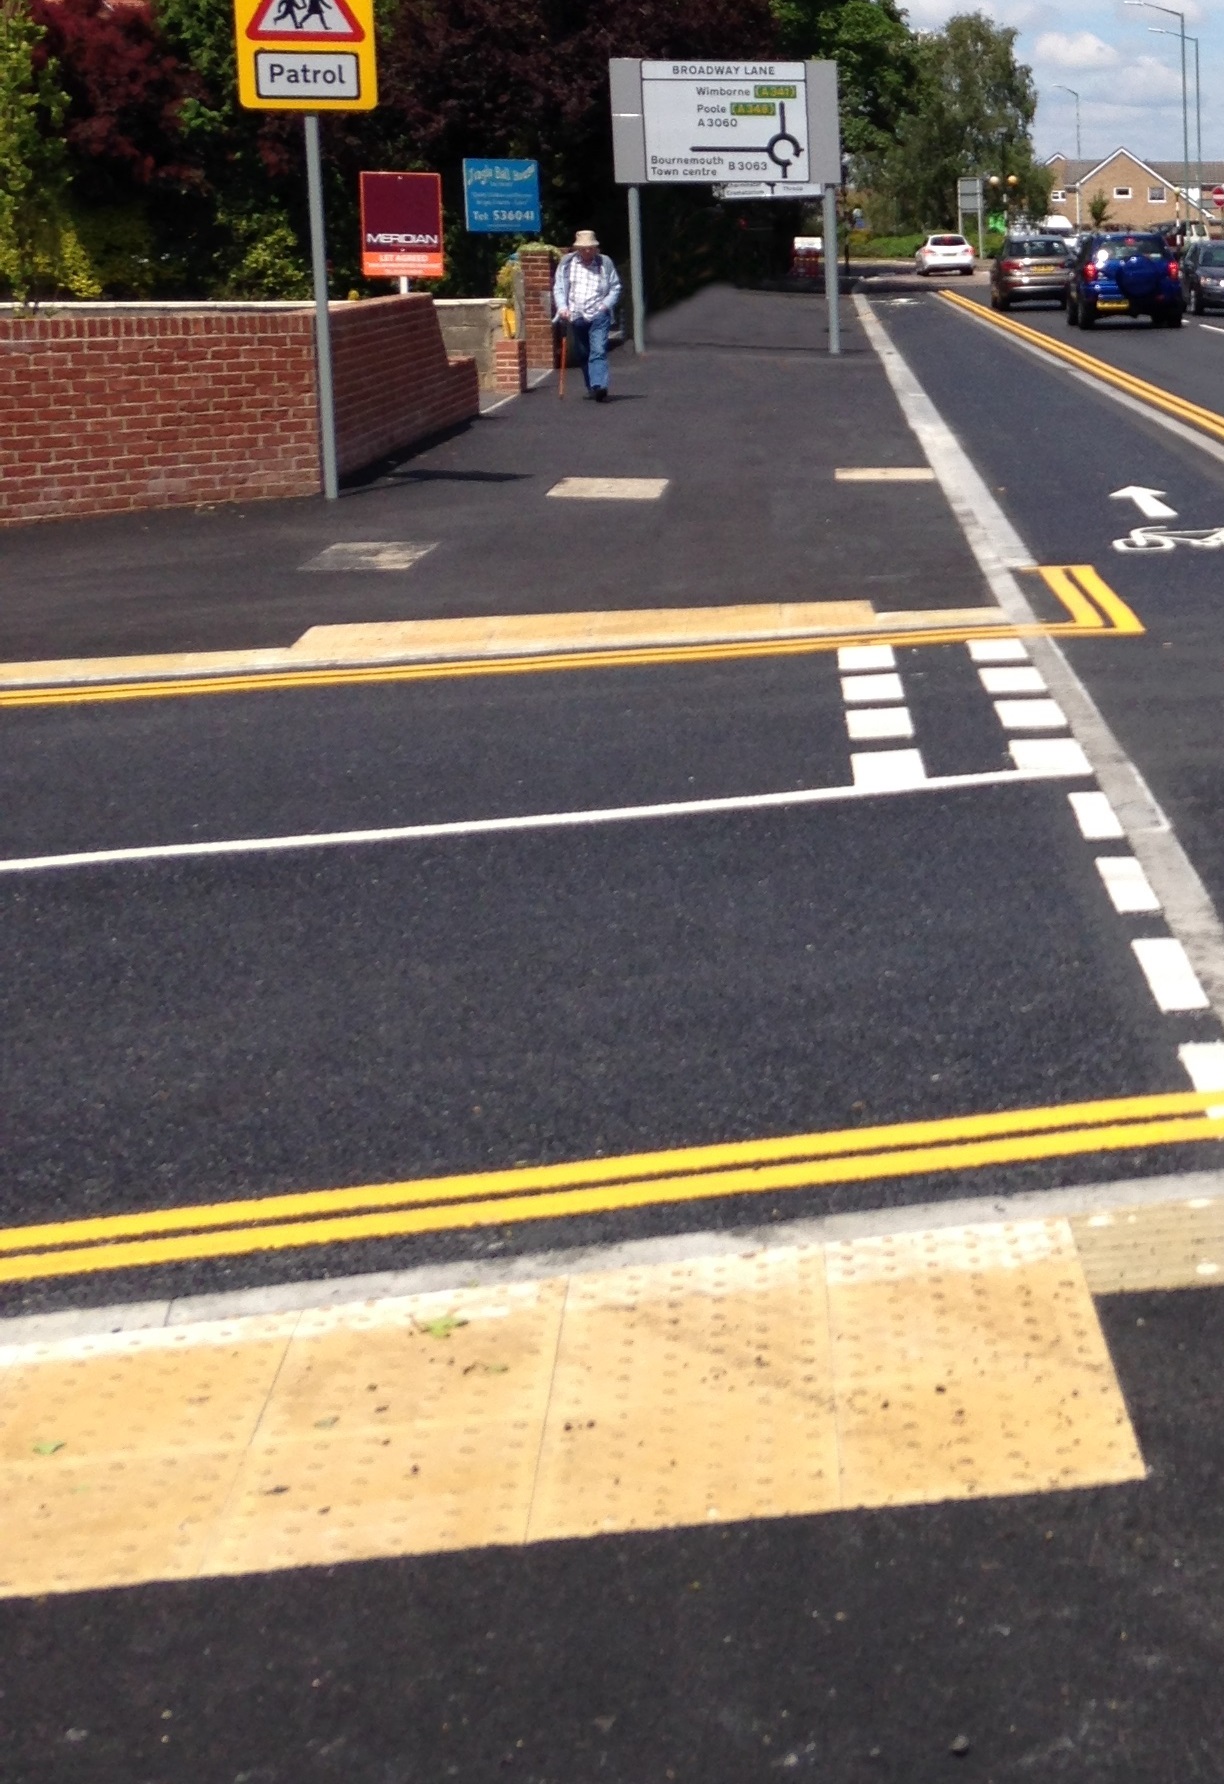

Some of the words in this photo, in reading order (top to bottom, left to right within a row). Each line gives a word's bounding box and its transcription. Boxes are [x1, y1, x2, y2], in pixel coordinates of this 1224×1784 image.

[269, 63, 346, 84] Patrol
[672, 65, 740, 76] BROADWAY
[744, 66, 775, 76] LANE
[696, 86, 750, 97] Wimborne
[696, 104, 727, 114] Poole
[651, 155, 724, 166] Bournemouth
[651, 166, 678, 176] Town
[682, 166, 717, 176] centre
[493, 209, 535, 222] 536041
[366, 232, 438, 245] MERIDIAN
